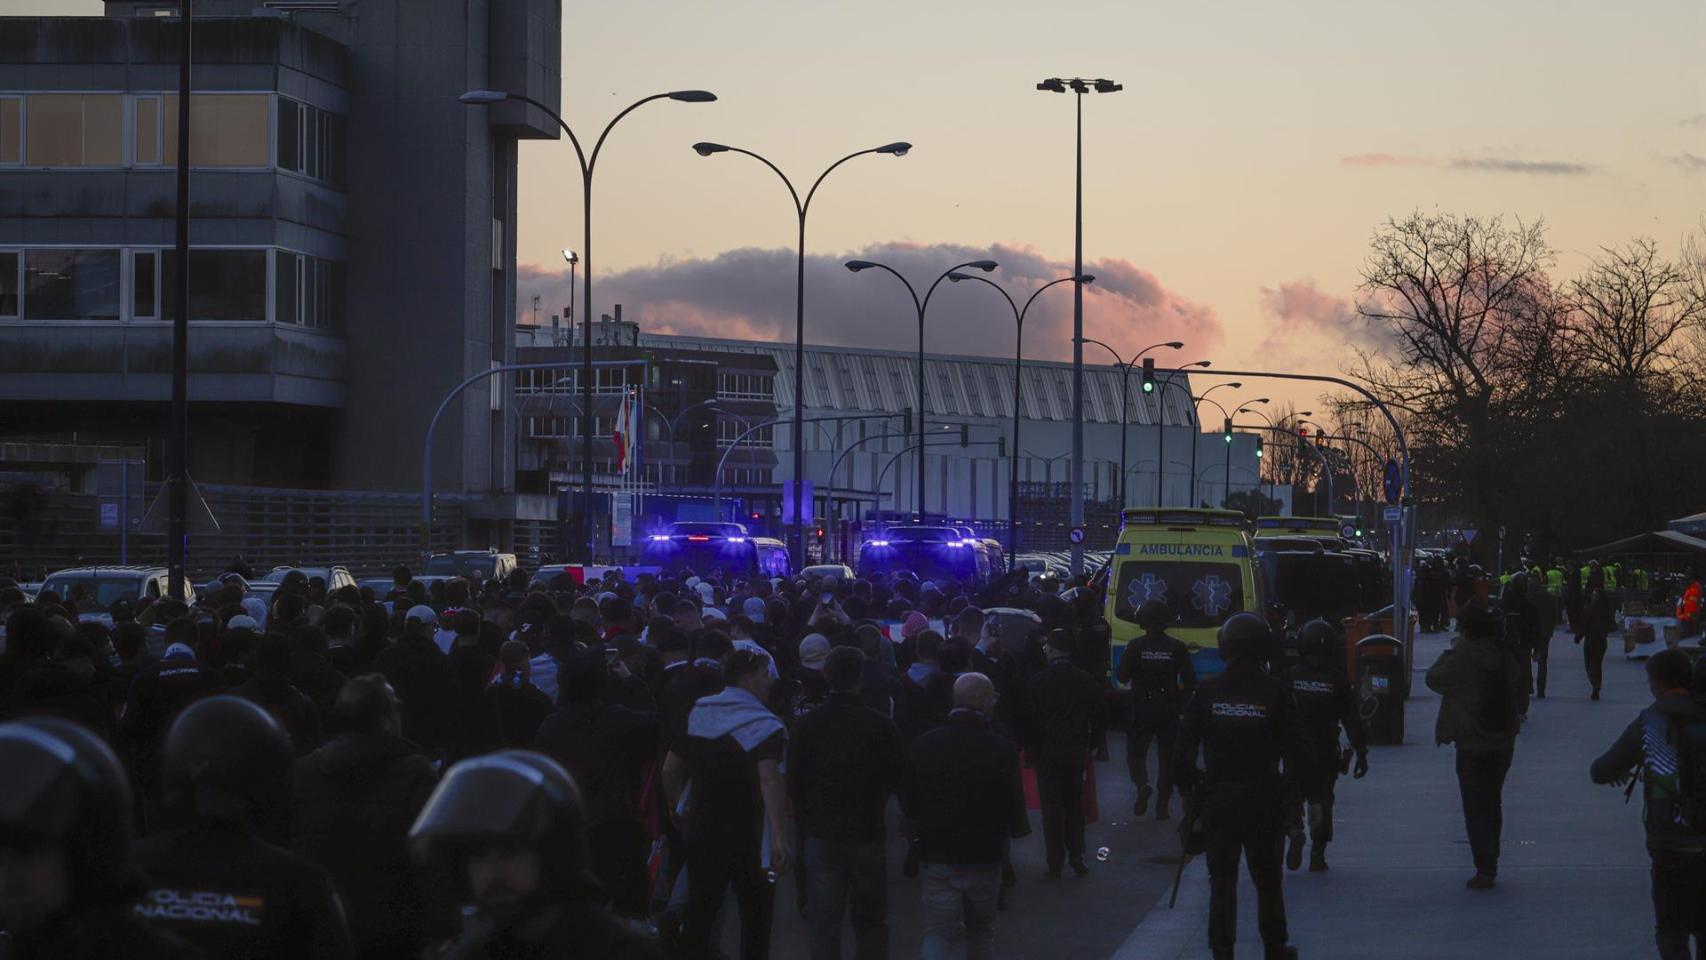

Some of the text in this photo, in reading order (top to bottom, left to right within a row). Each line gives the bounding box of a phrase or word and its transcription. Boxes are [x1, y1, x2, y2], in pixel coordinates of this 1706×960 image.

[1139, 544, 1224, 556] AMBULANCIA
[1212, 703, 1255, 711] POLICIA
[1211, 709, 1266, 718] NACIONAL
[132, 903, 262, 925] NACIONAL
